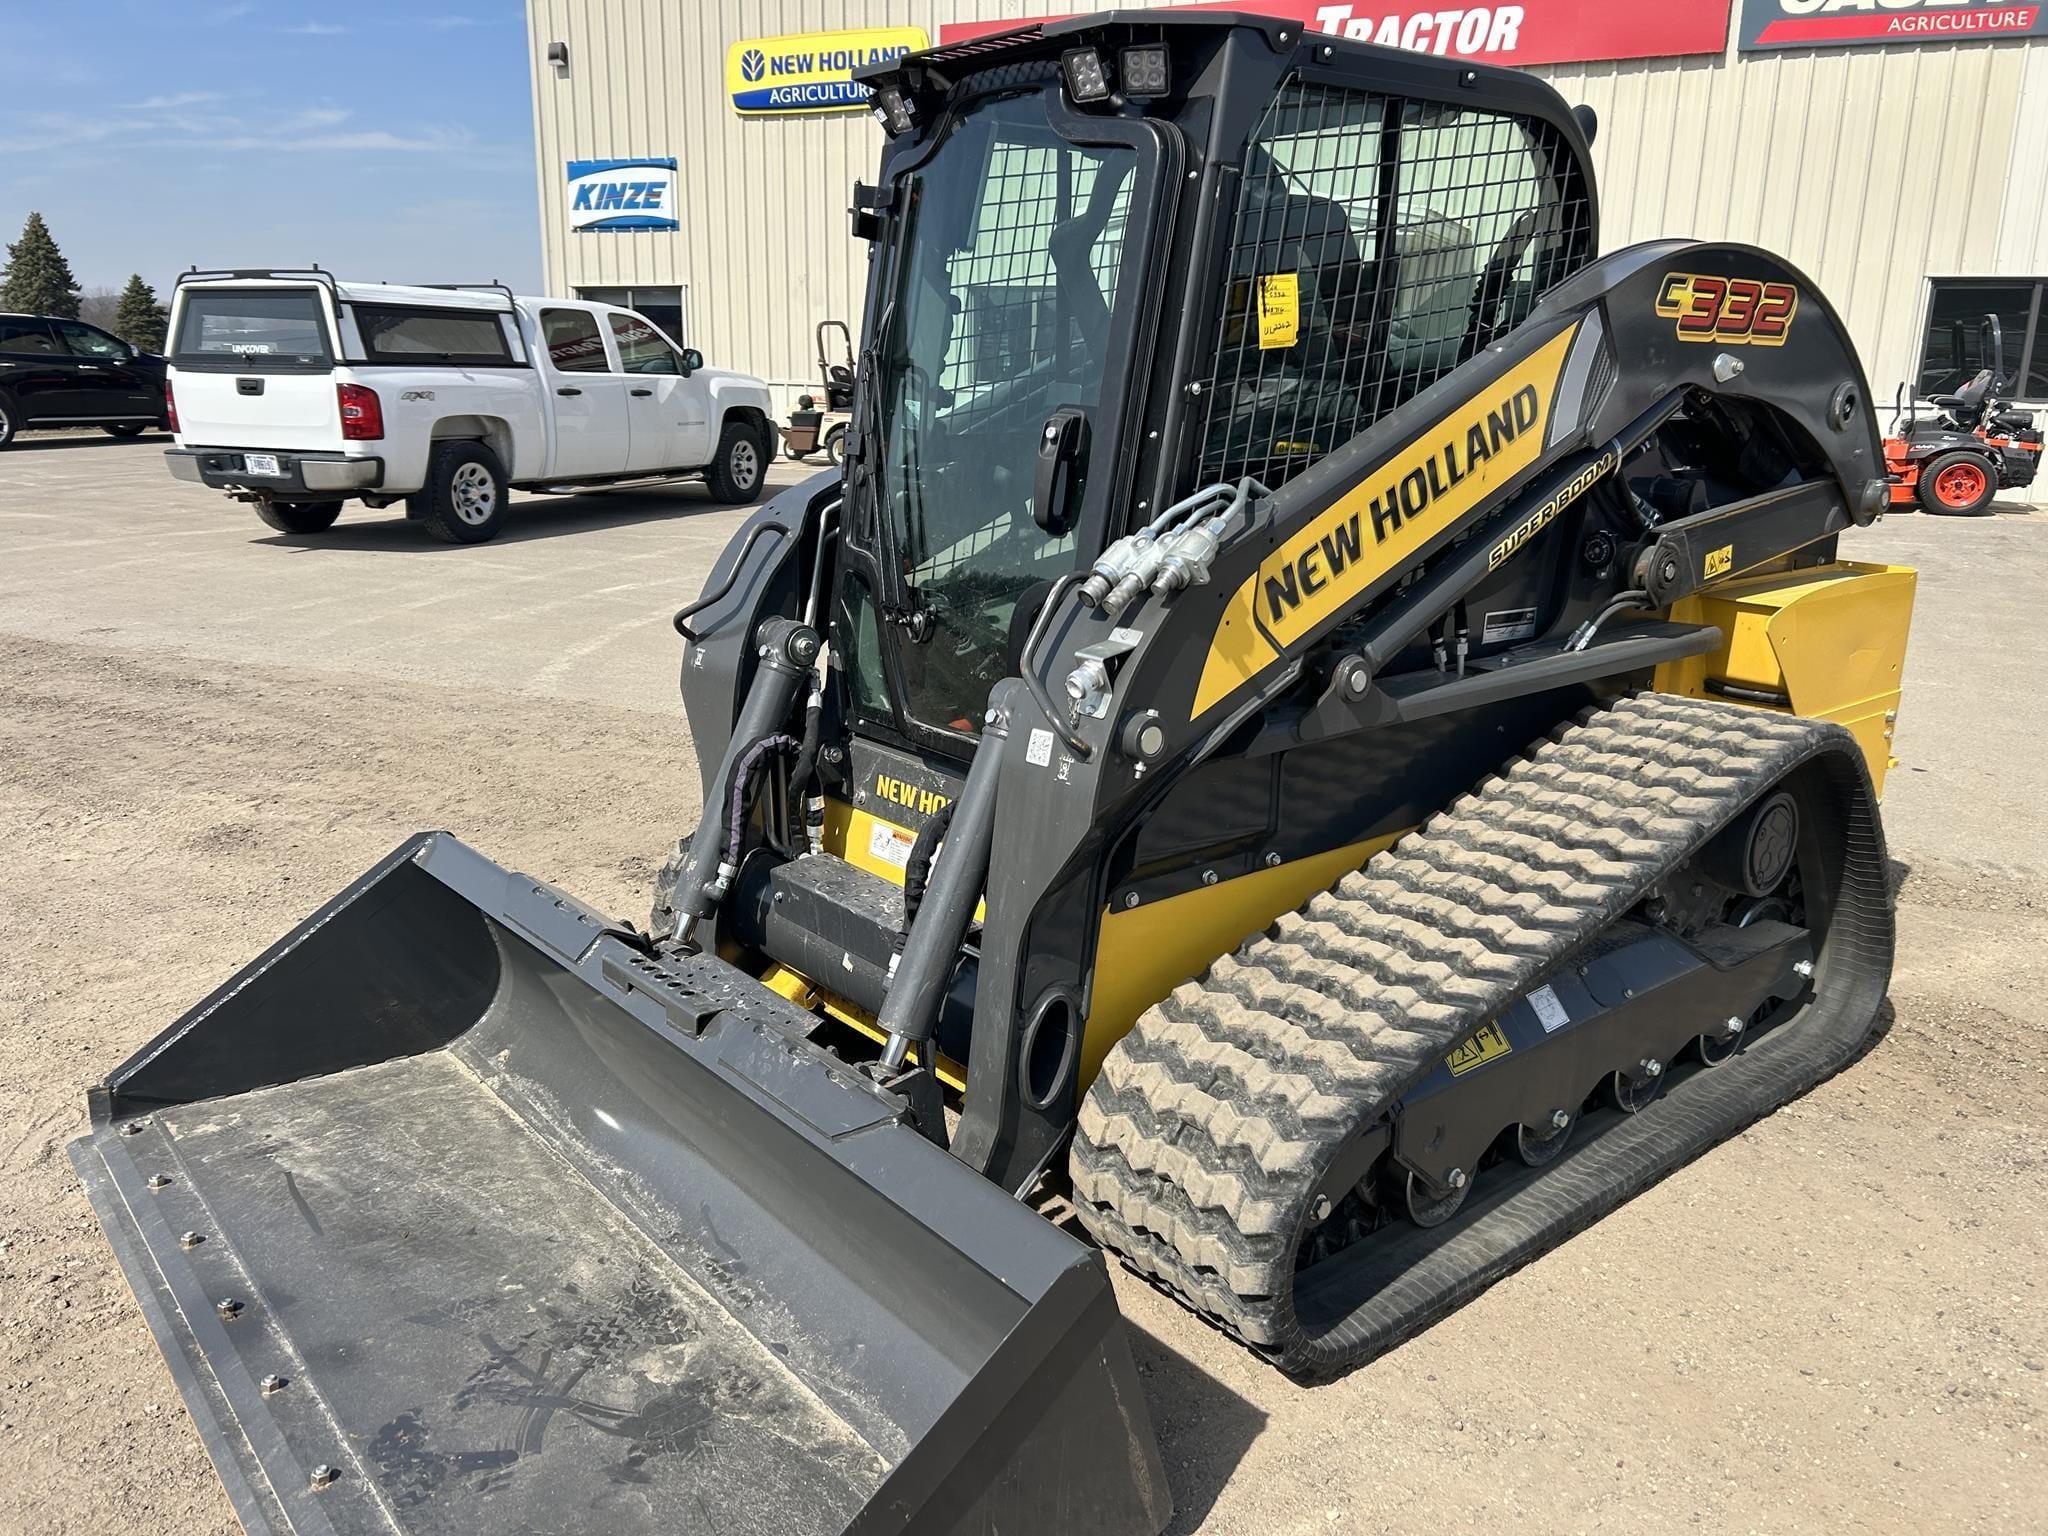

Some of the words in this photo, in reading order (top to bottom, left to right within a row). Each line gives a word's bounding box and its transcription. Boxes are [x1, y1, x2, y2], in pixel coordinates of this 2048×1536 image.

[1316, 4, 1524, 56] TRACTOR
[1887, 10, 2029, 33] AGRICULTURE
[770, 53, 814, 76] NEW
[572, 181, 668, 211] KINZE
[1656, 274, 1797, 342] C332
[1263, 511, 1363, 625] NEW
[1368, 383, 1540, 545] HOLLAND
[1488, 501, 1556, 571] SUPER
[1556, 453, 1612, 513] BOOM
[876, 774, 918, 809] NEW
